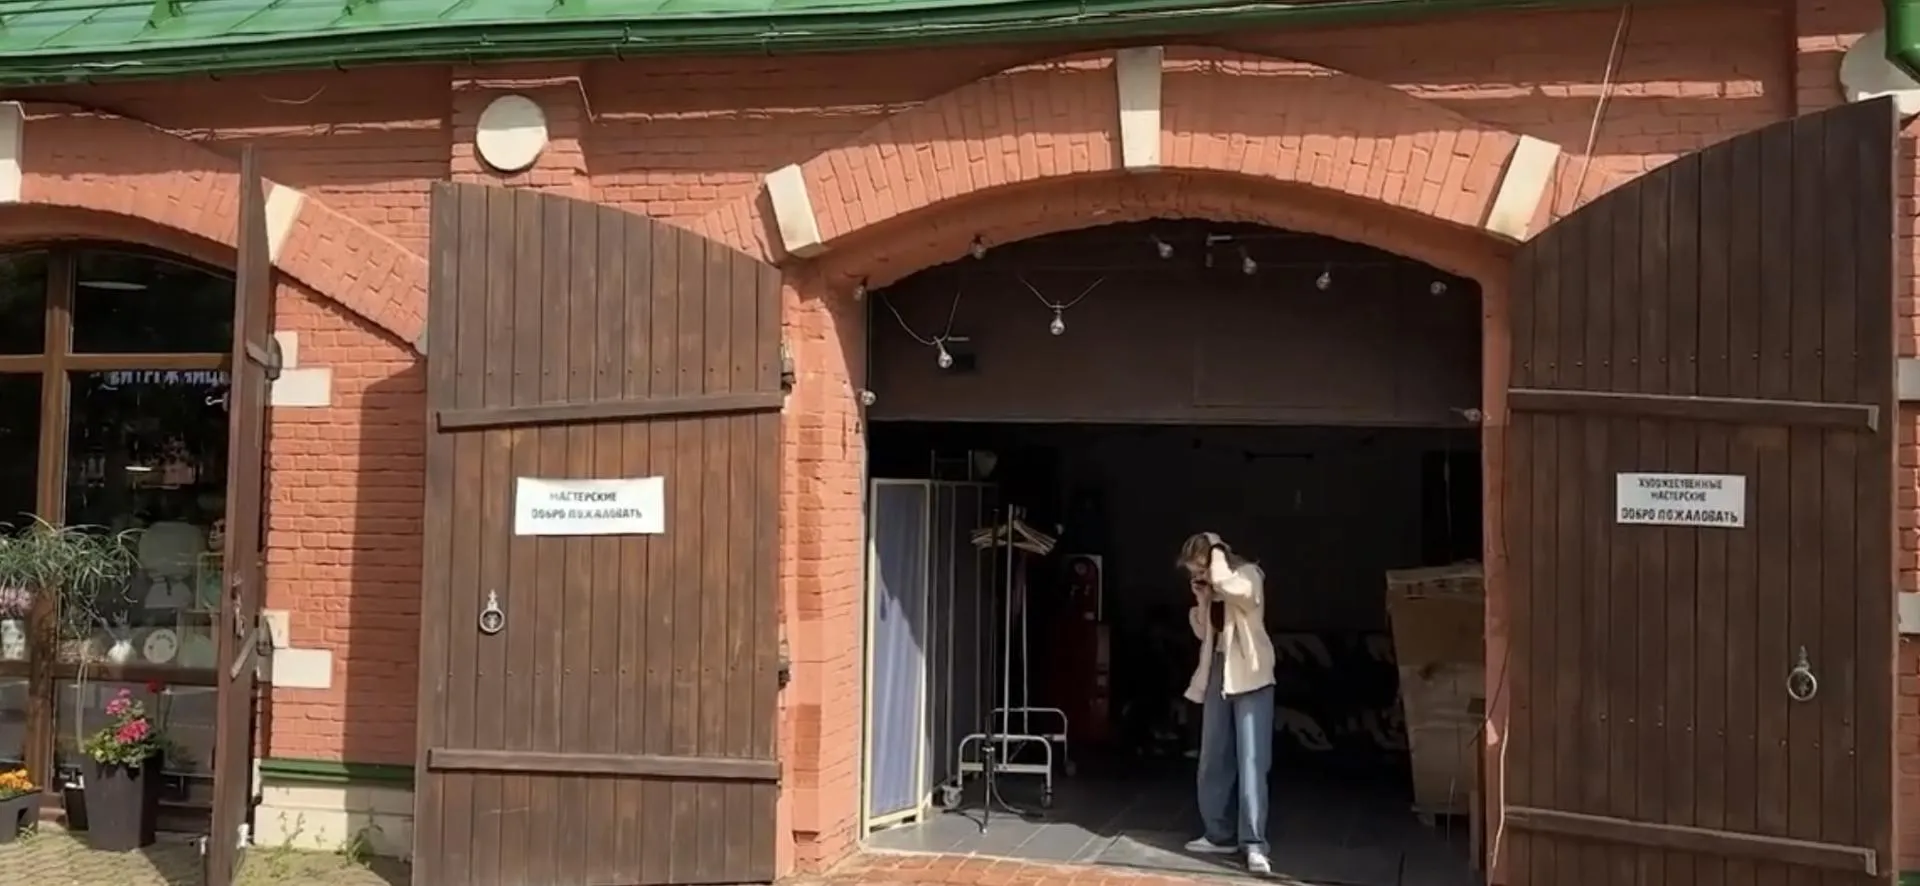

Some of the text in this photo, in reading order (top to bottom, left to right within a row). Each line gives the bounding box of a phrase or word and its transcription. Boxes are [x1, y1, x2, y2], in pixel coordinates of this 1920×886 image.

[1638, 478, 1723, 489] ХУДОЖЕСТВЕННЫЕ
[549, 491, 617, 502] МАСТЕРСКИЕ
[1650, 491, 1707, 501] МАСТЕРСКИЕ
[531, 508, 642, 519] ДОБРО ПОЖАЛОВАТЬ
[1621, 507, 1738, 523] ДОБРО ПОЖАЛОВАТЬ
